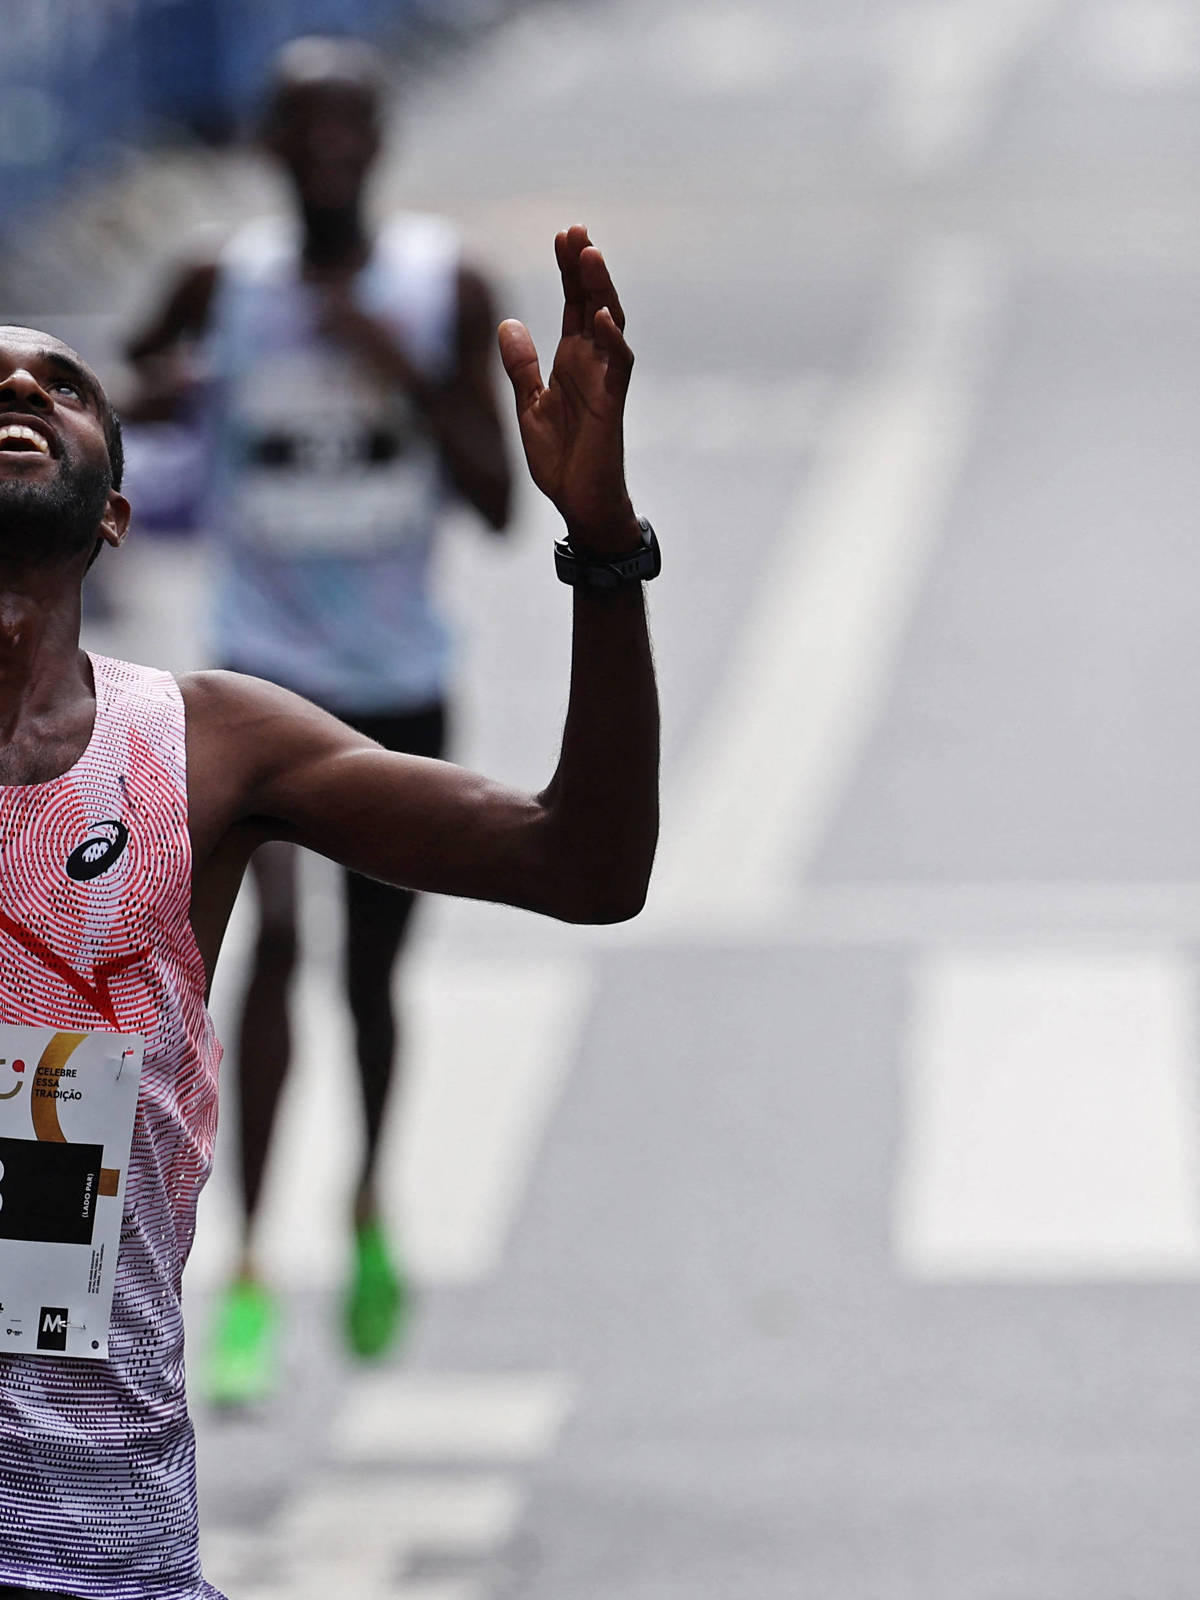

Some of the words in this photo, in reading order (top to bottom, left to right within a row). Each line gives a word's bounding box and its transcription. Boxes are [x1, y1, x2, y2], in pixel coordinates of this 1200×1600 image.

[37, 1066, 77, 1078] CELEBRE
[36, 1078, 60, 1088] ESSA
[35, 1088, 82, 1102] TRADIÇÃO
[85, 1173, 95, 1192] PAR)
[81, 1193, 91, 1218] (LADO
[42, 1313, 62, 1333] M
